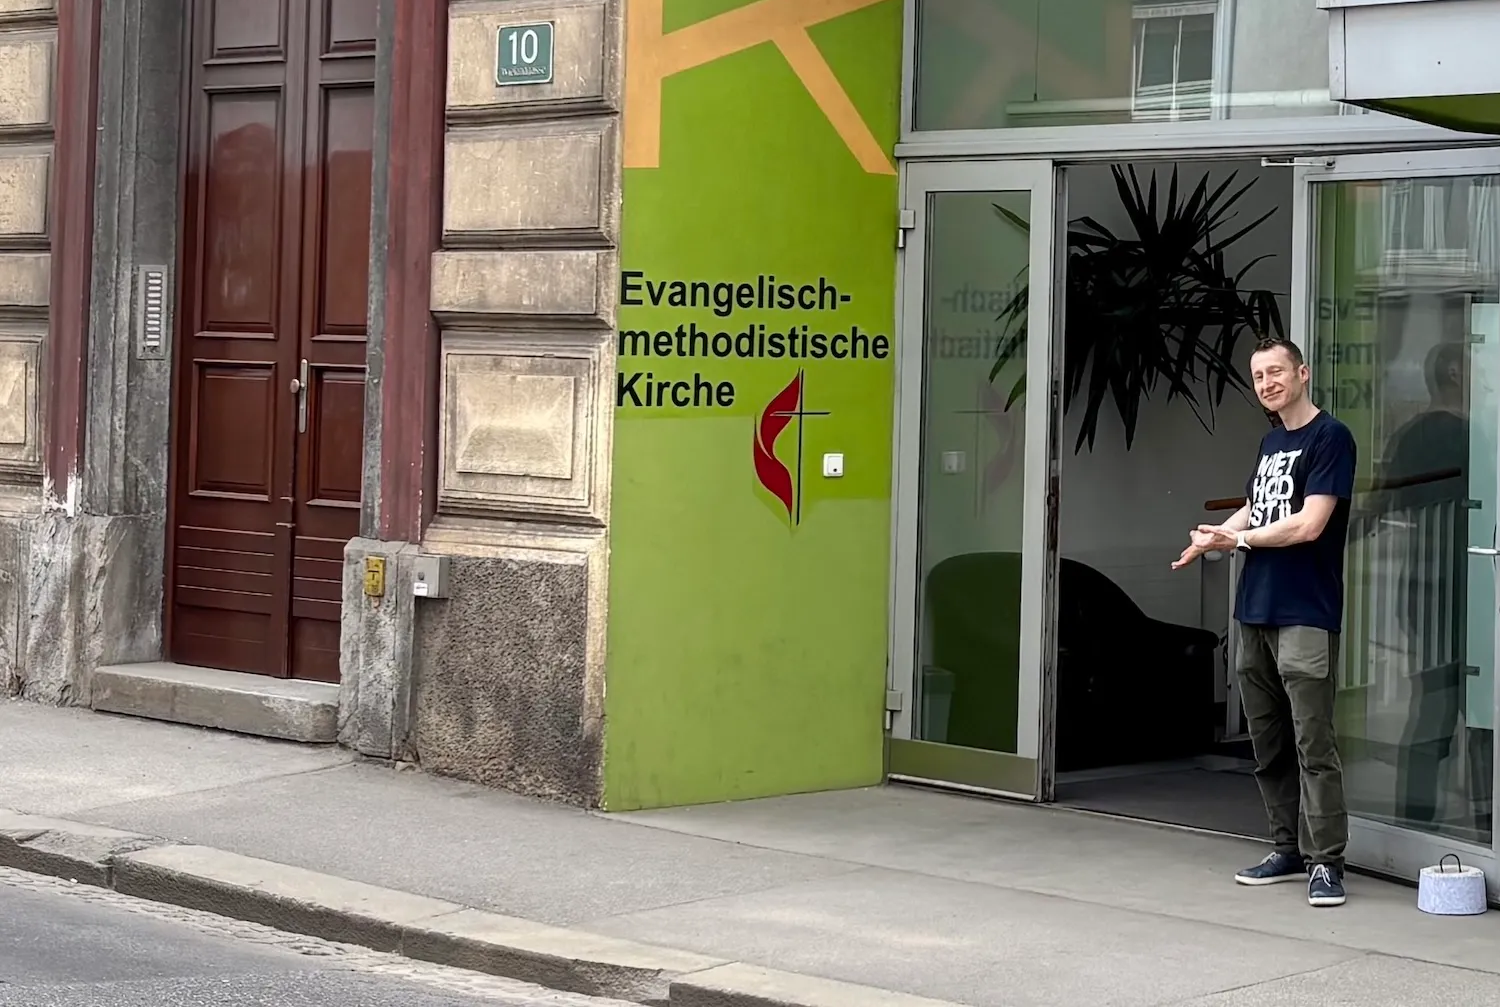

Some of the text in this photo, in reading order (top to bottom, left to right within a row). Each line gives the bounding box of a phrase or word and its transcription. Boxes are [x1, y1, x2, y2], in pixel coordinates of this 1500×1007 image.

[508, 29, 539, 65] 10
[619, 270, 851, 317] Evangelisch-
[618, 322, 890, 359] methodistische
[616, 372, 736, 408] Kirche
[1256, 449, 1303, 478] MET
